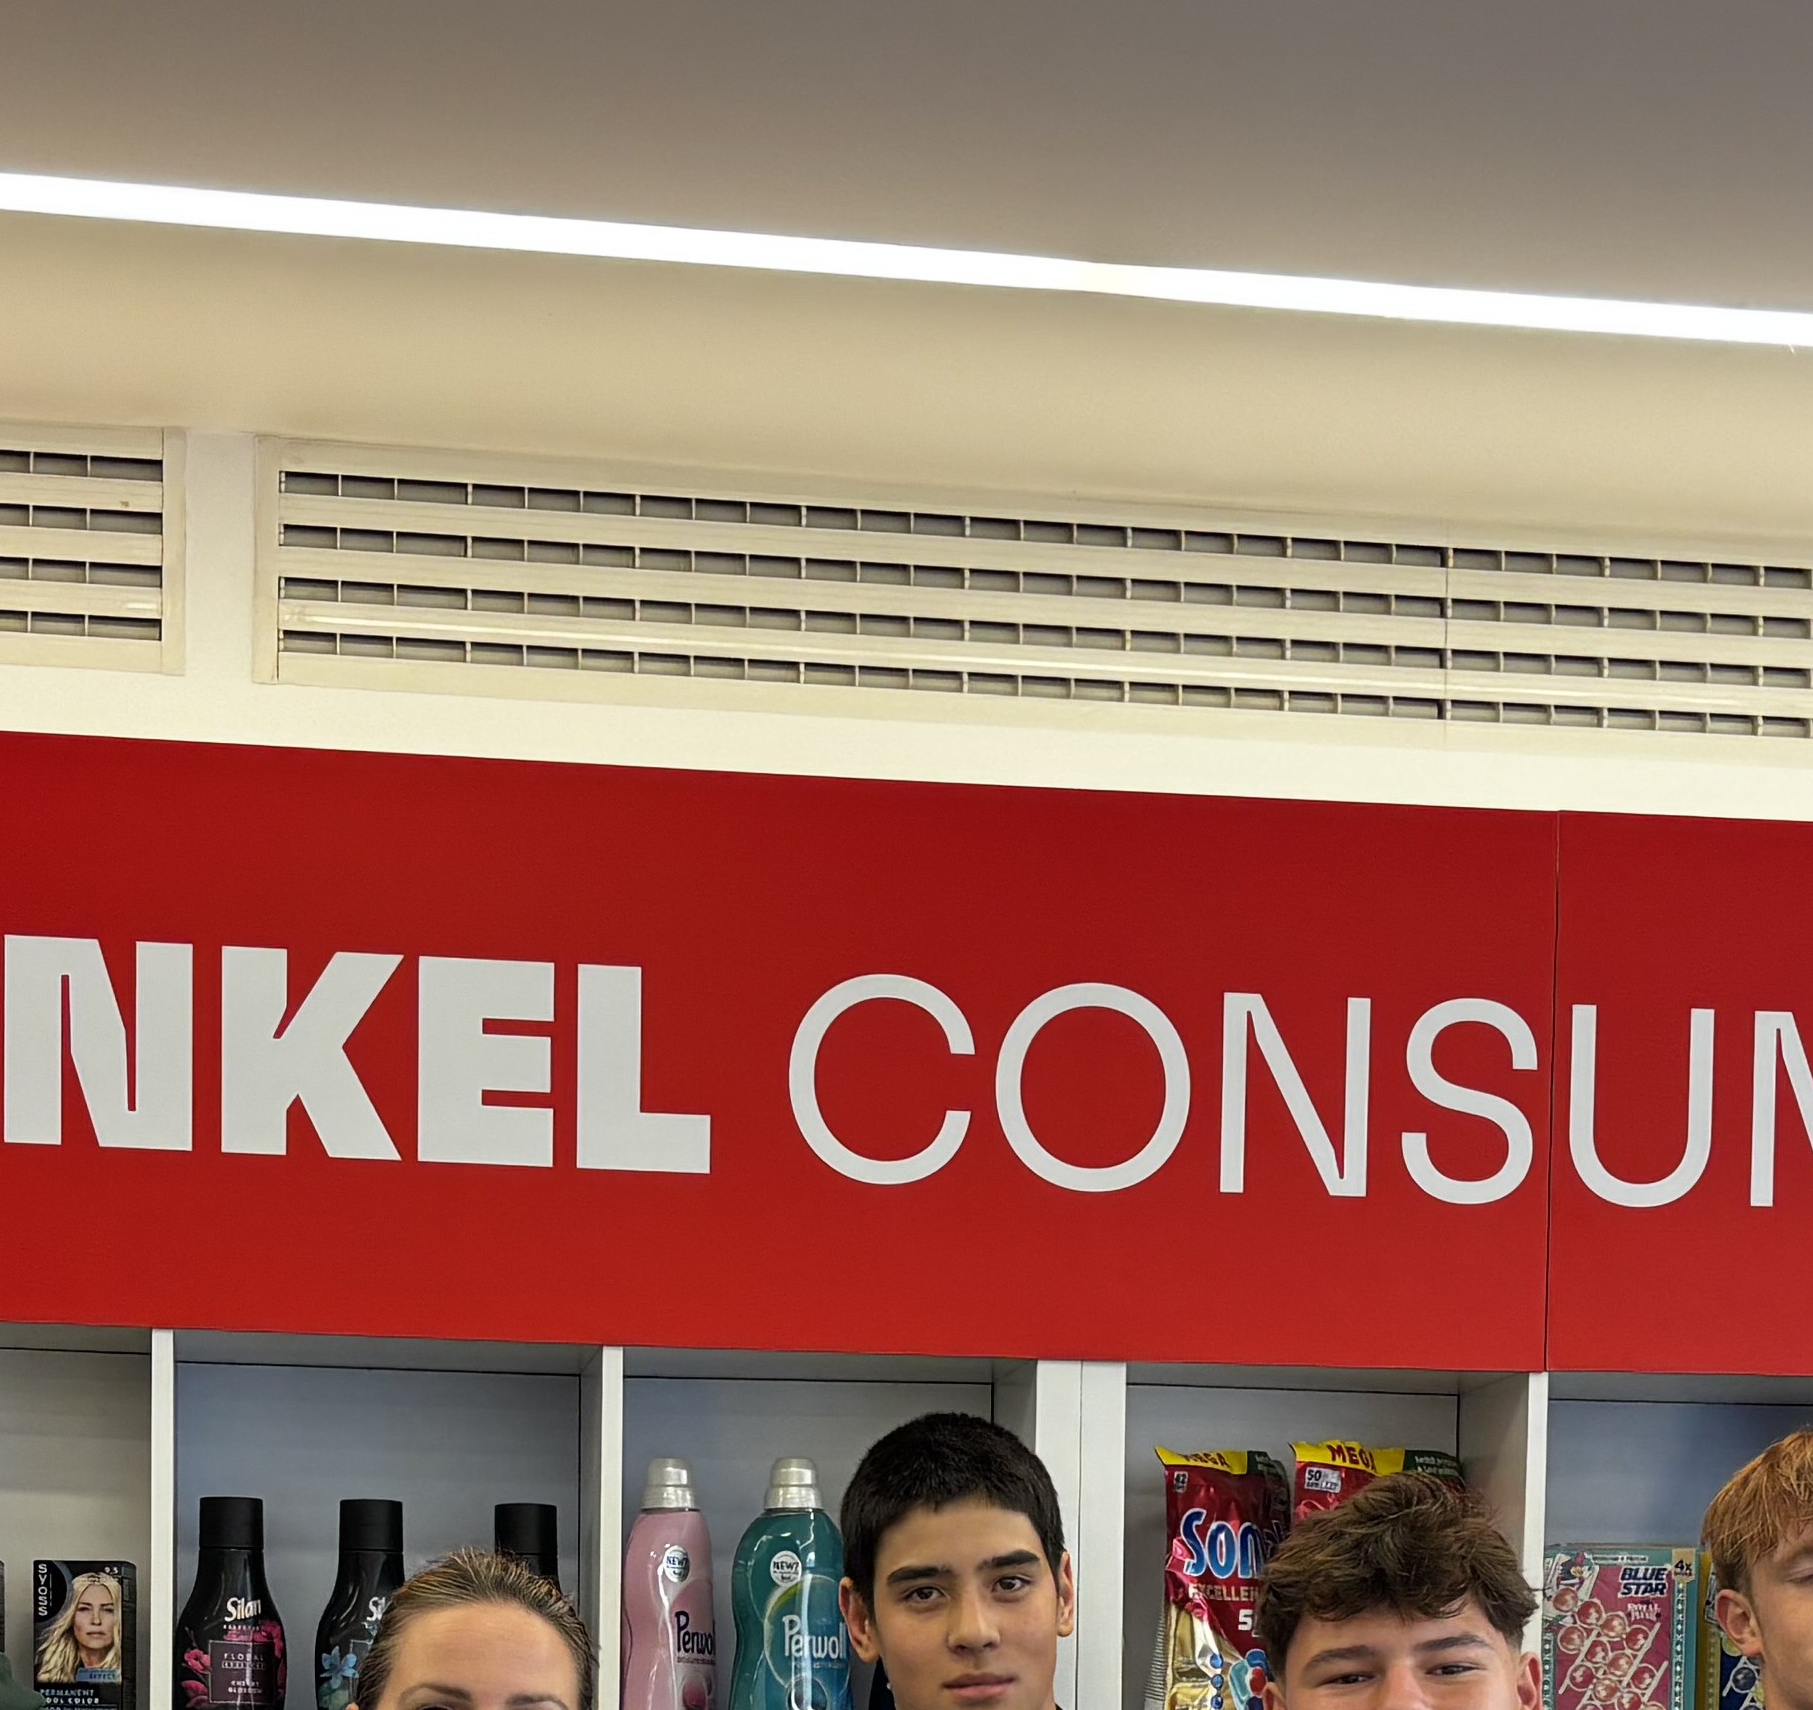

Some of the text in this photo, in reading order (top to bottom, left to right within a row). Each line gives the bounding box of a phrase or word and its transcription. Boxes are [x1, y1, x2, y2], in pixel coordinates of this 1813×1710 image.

[1620, 1567, 1668, 1581] BLUE
[1620, 1582, 1667, 1596] STAR
[224, 1597, 262, 1622] Silan
[782, 1614, 847, 1660] Perwoll
